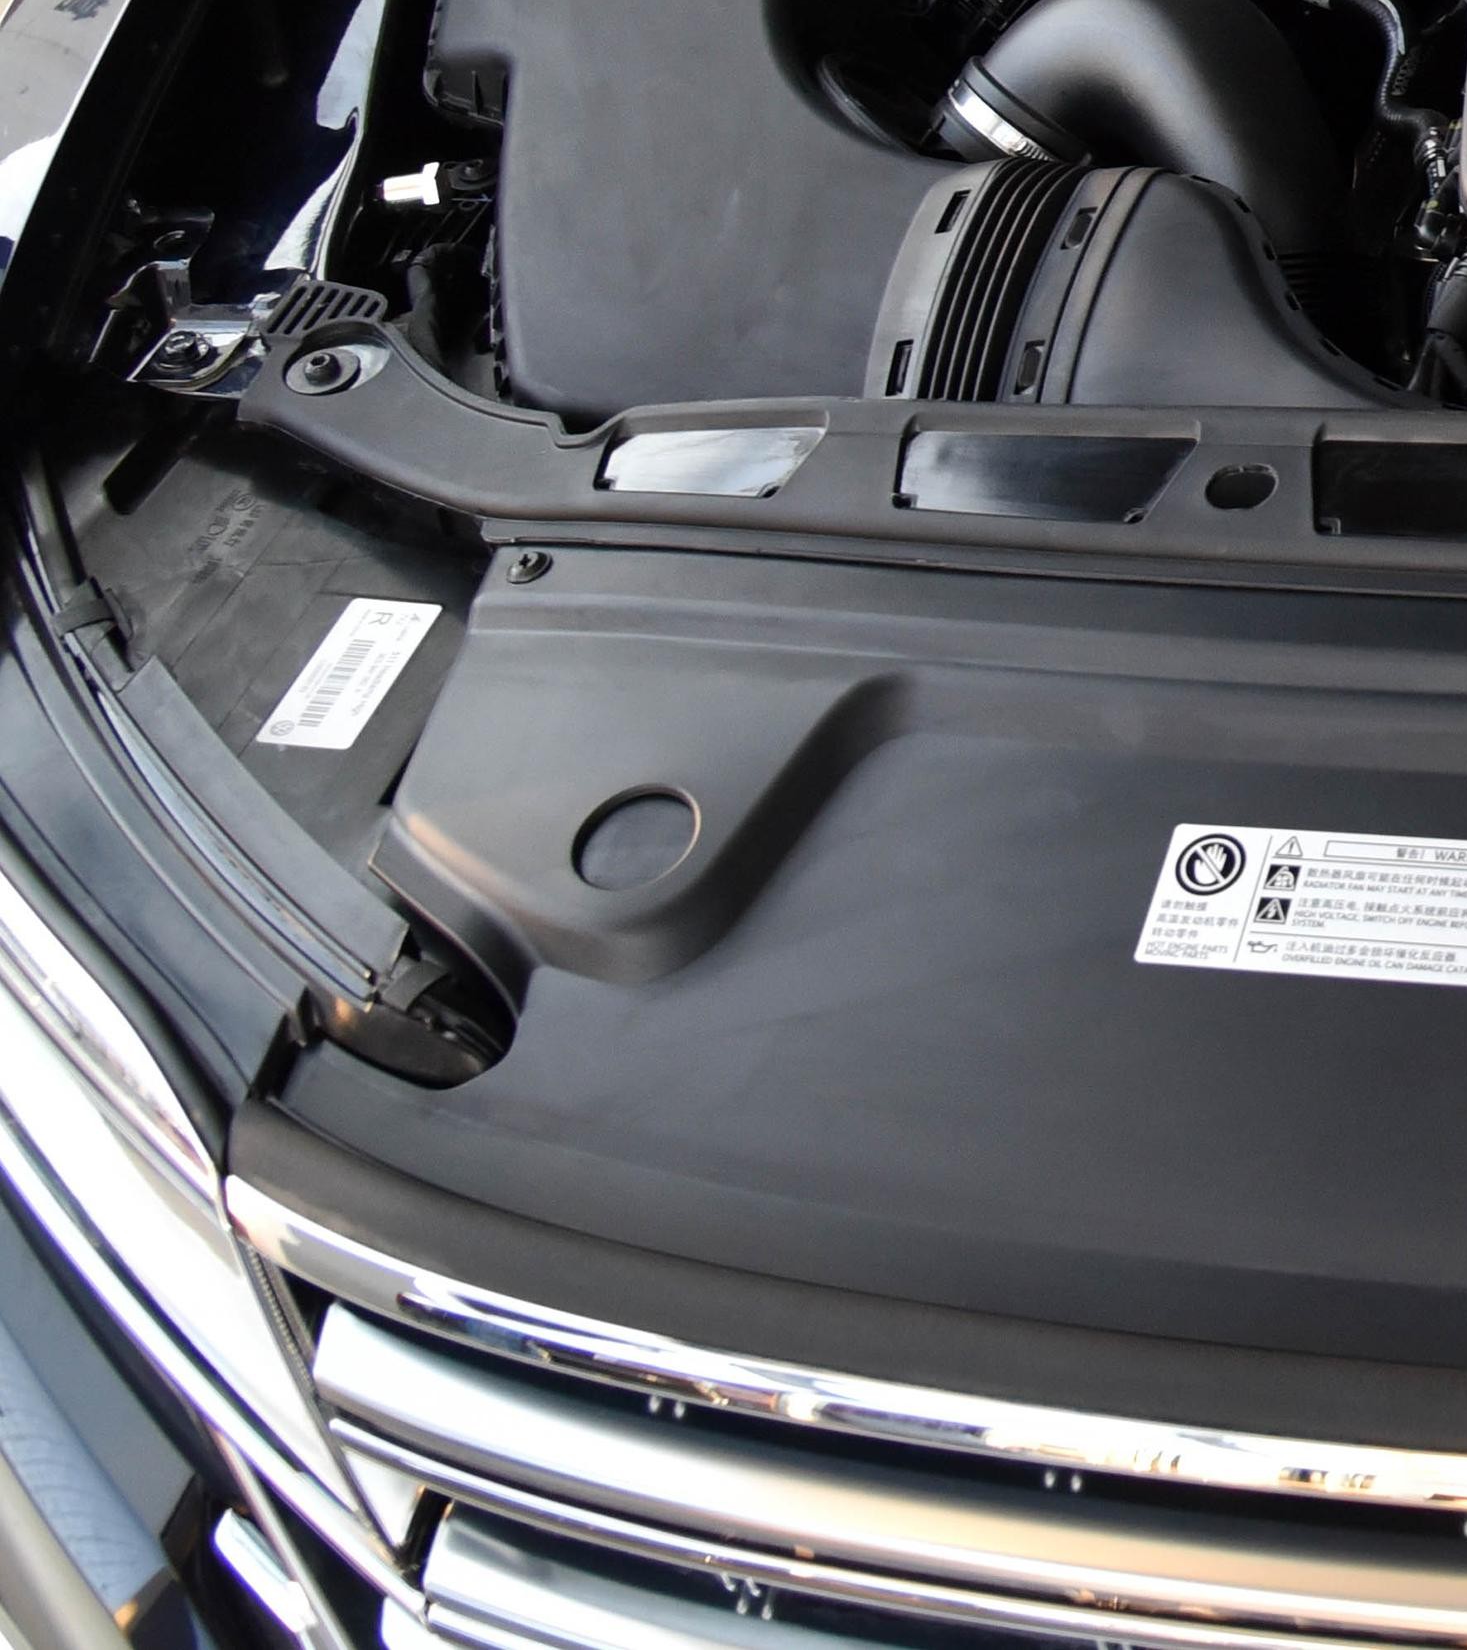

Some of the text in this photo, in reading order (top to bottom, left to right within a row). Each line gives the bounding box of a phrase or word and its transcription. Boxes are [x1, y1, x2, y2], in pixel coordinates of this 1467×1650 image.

[367, 611, 394, 626] R
[1366, 882, 1385, 893] MAY
[1387, 883, 1413, 895] START
[1416, 885, 1428, 896] AT
[1429, 886, 1447, 897] ANY
[1293, 909, 1316, 919] HIGH
[1362, 912, 1396, 924] SWITCH
[1398, 914, 1413, 925] OFF
[1416, 916, 1448, 928] ENGINE
[1168, 941, 1200, 951] ENGINE
[1201, 944, 1229, 954] PARTS
[1281, 952, 1333, 965] OVERFILLED
[1335, 956, 1366, 967] ENGINE
[1368, 958, 1382, 968] OIL
[1384, 960, 1404, 970] CAN
[1405, 962, 1444, 973] DAMAGE
